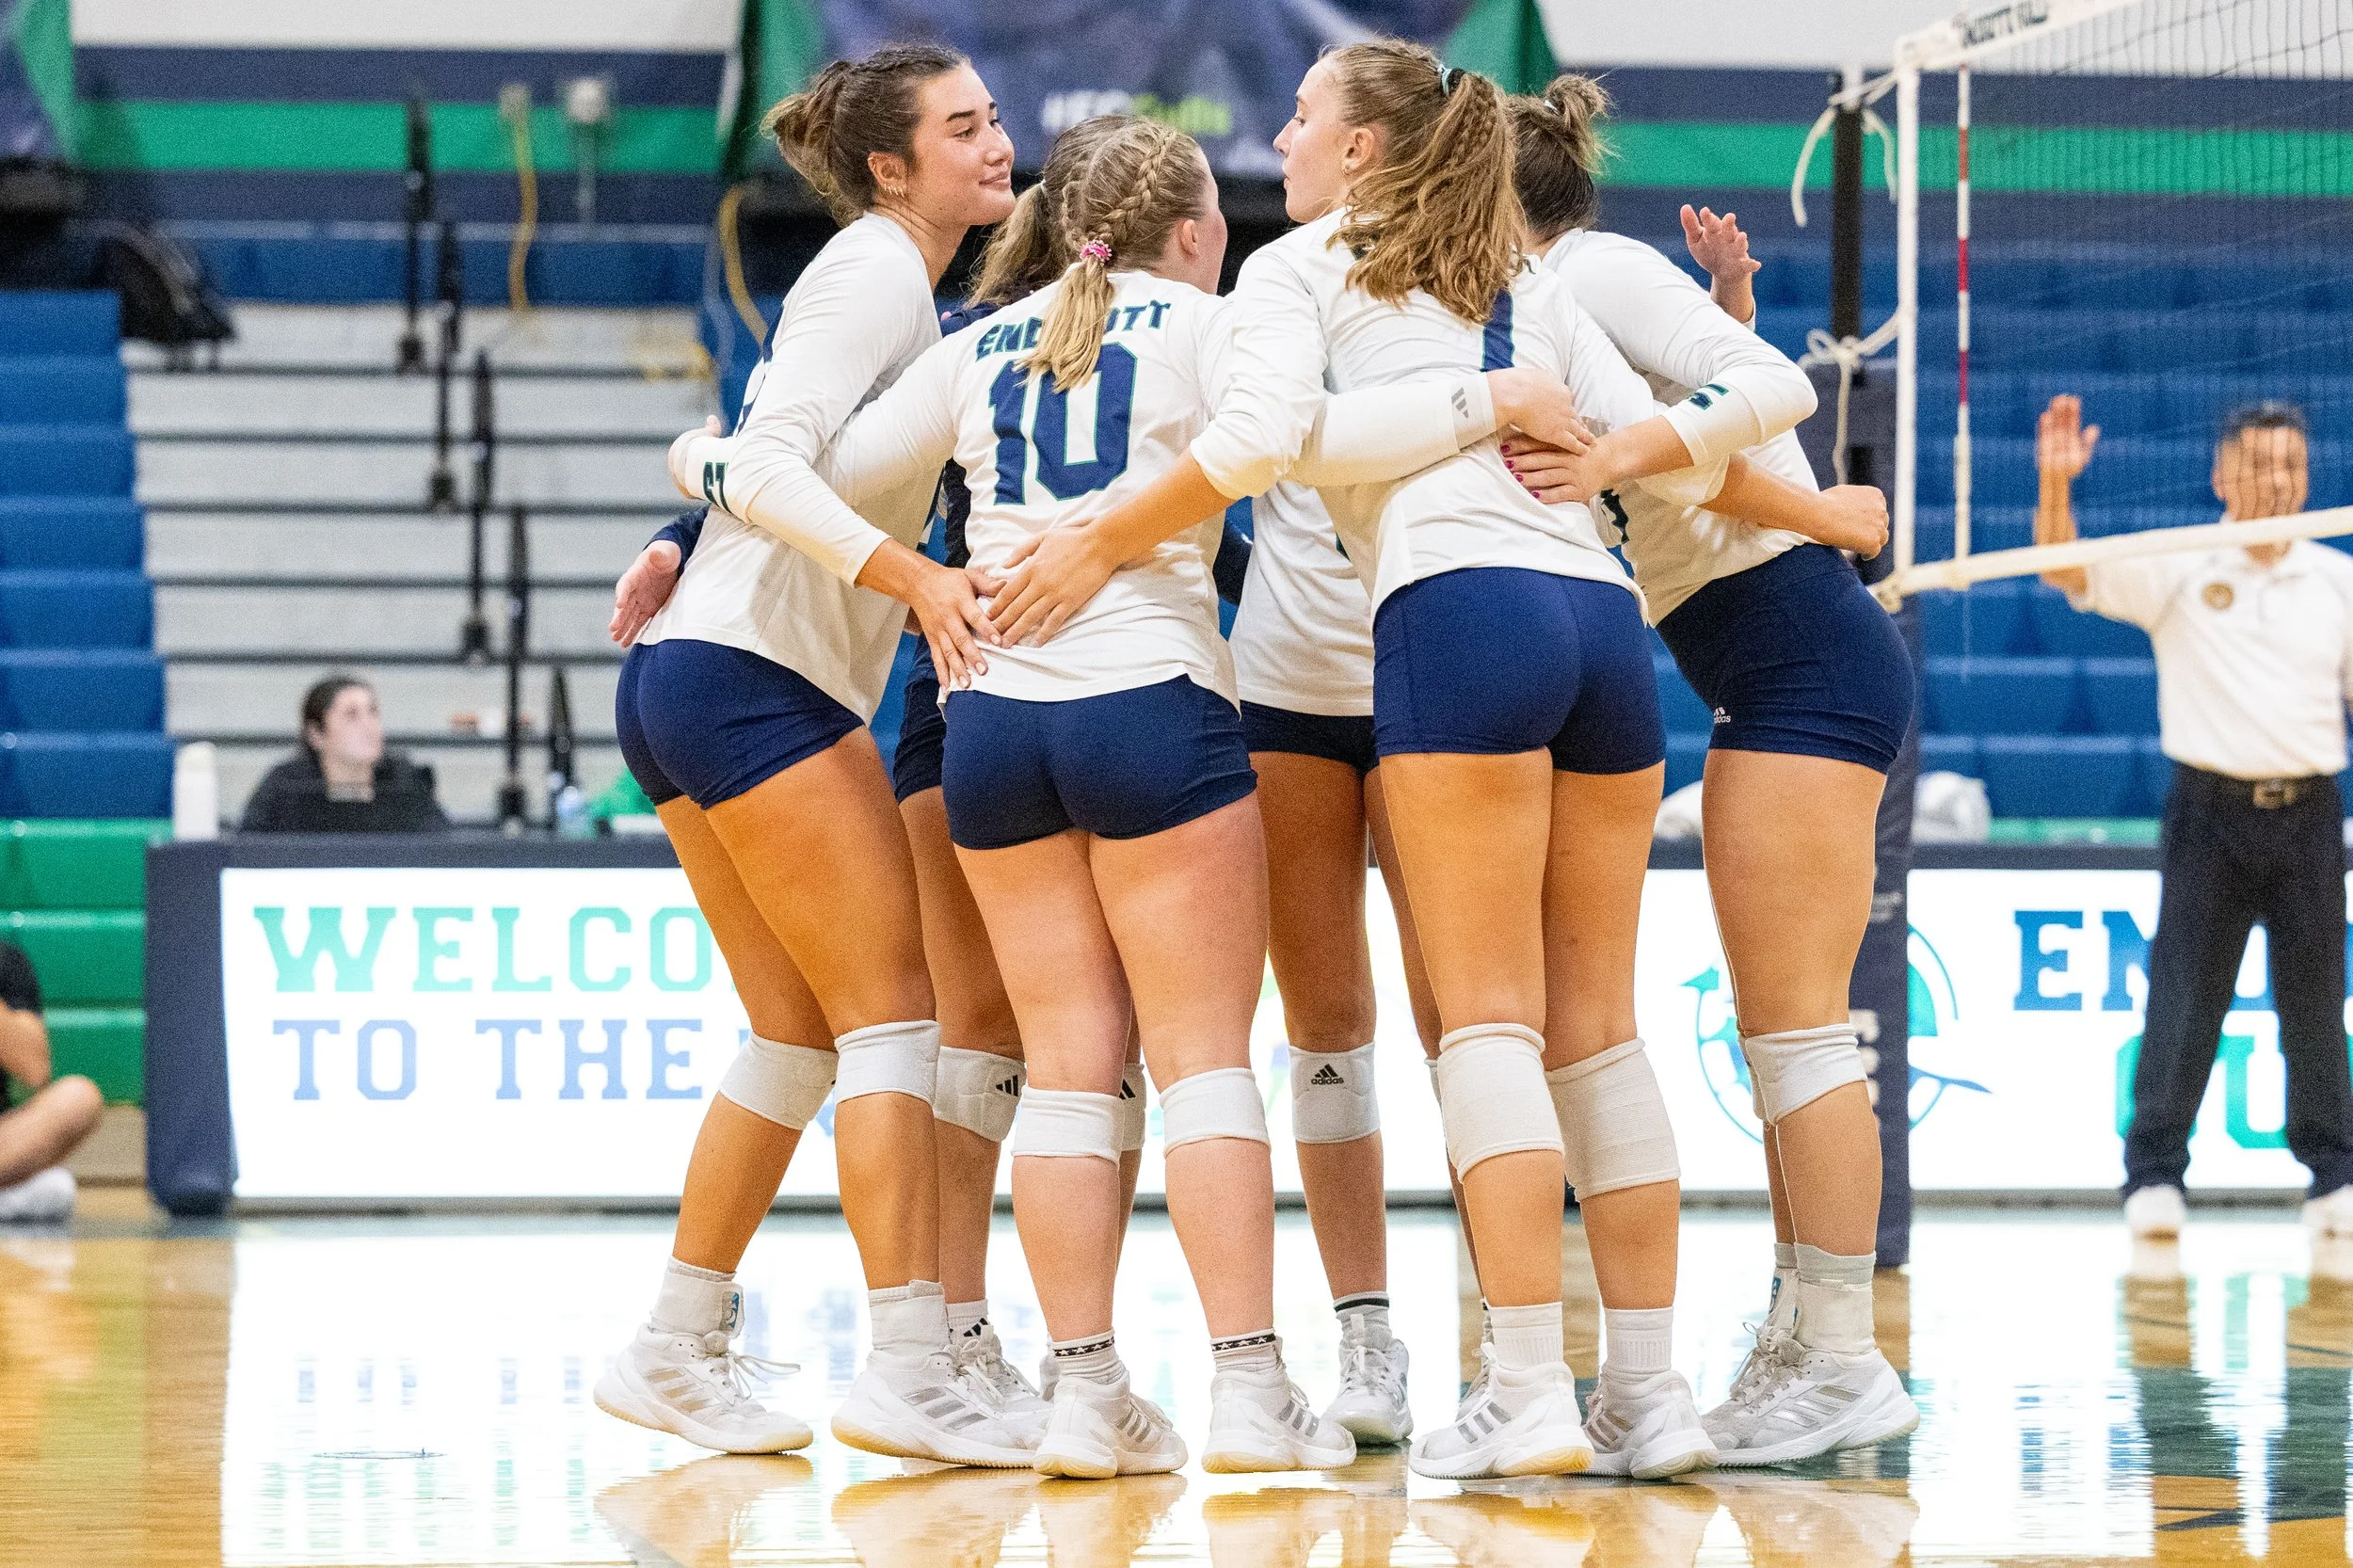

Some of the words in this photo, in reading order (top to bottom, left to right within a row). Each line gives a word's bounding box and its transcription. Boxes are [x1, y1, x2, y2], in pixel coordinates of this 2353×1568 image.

[988, 341, 1138, 505] 10
[253, 906, 738, 992] WELCO
[273, 1019, 417, 1100] TO
[475, 1019, 703, 1099] THE
[1310, 1077, 1345, 1085] adidas
